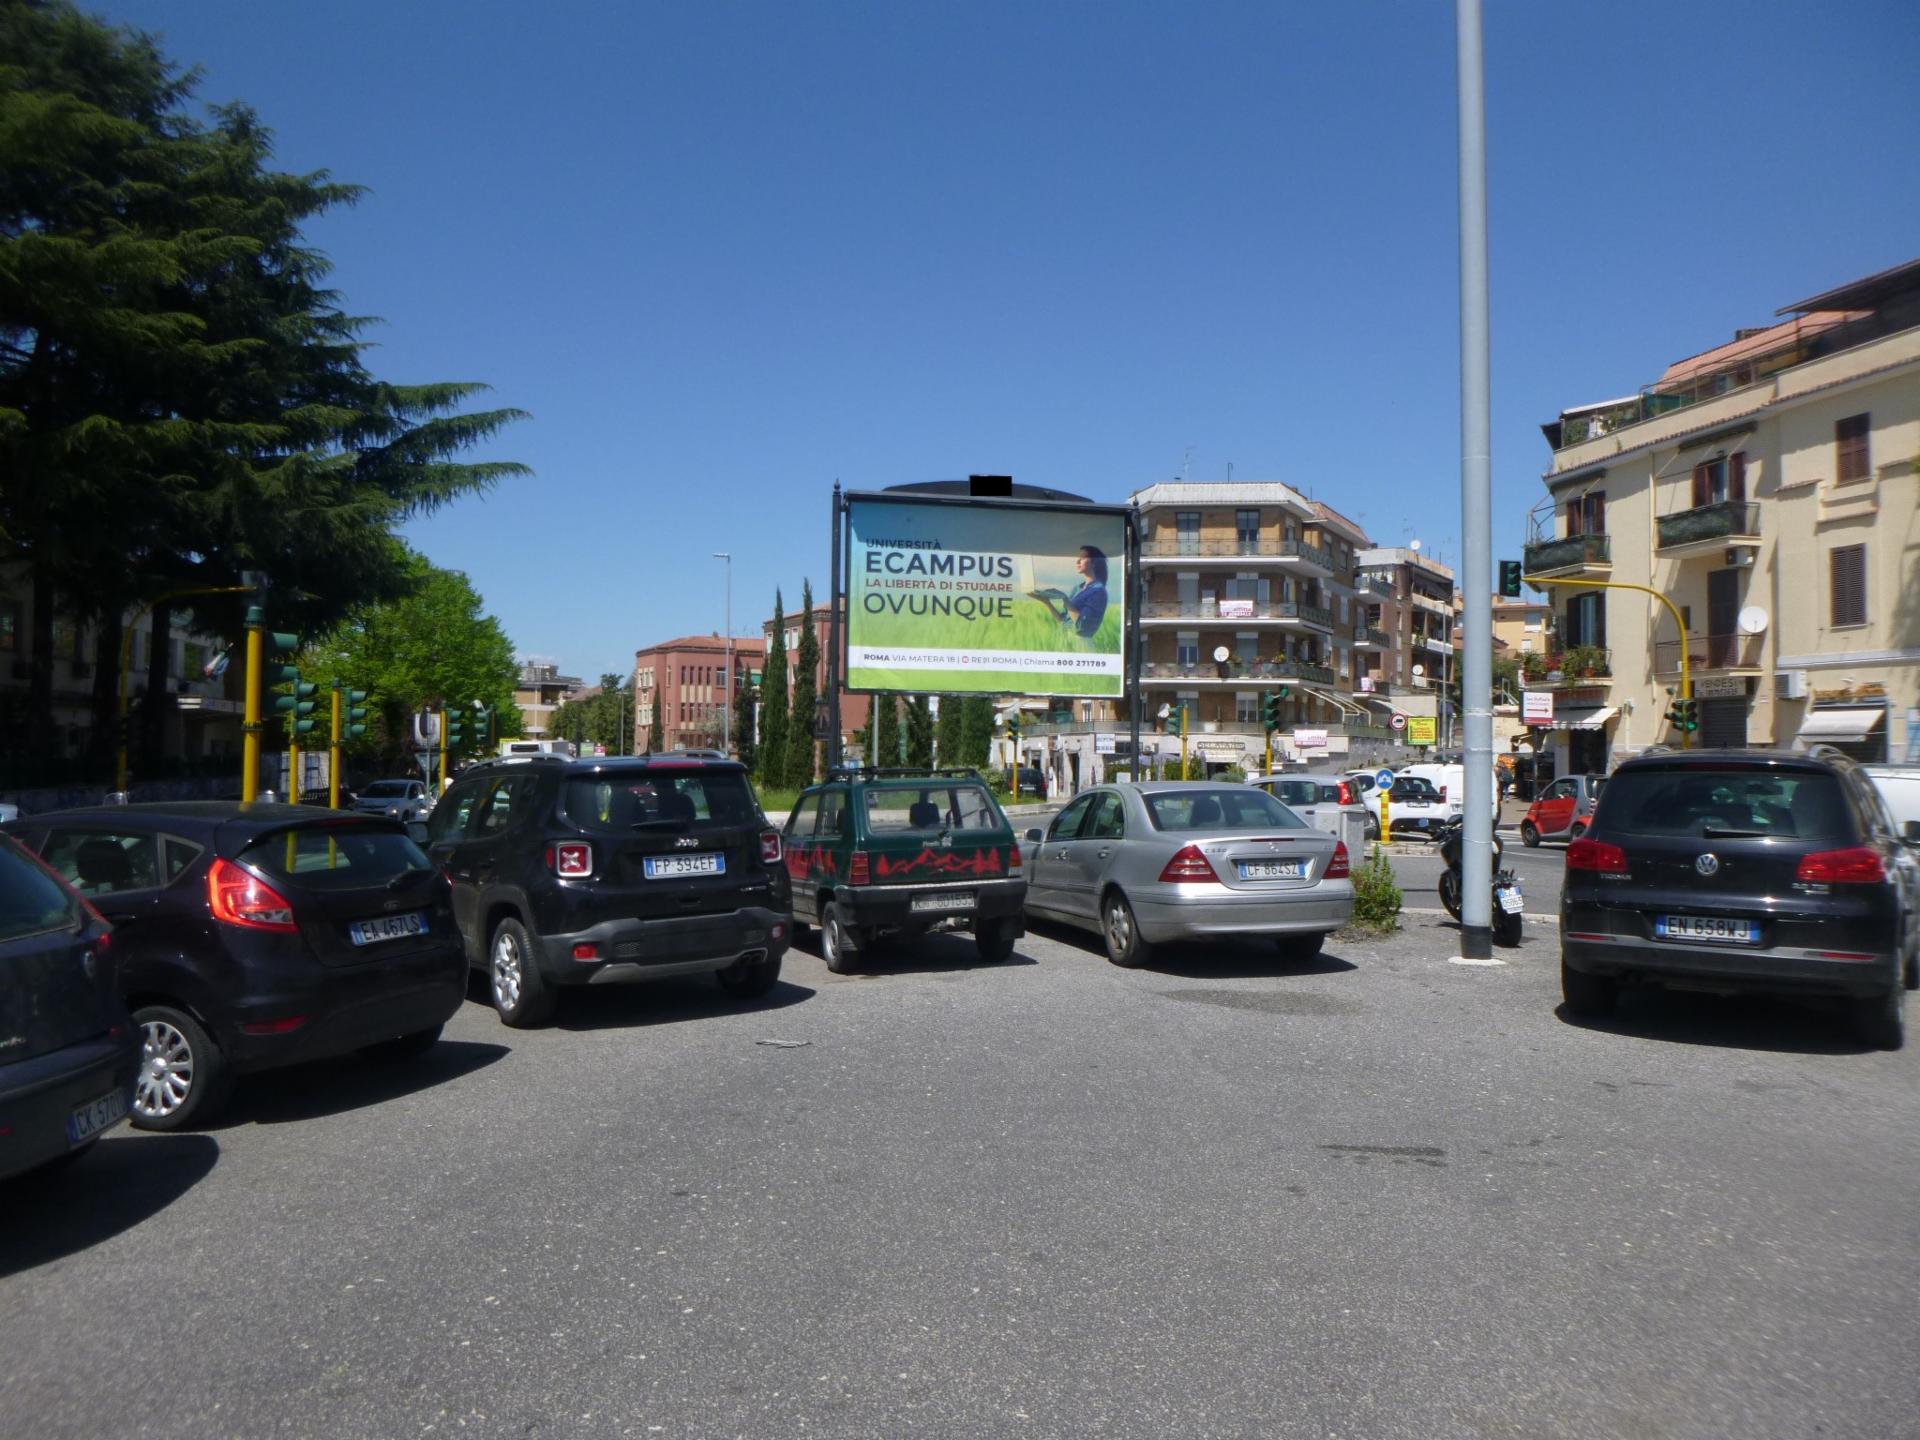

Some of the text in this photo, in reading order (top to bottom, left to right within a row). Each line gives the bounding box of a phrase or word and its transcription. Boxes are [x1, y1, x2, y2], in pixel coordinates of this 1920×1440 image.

[866, 538, 942, 550] UNIVERSITÀ
[866, 551, 1013, 578] ECAMPUS
[865, 578, 1013, 592] LA LIBERTÀ DI STUDIARE
[864, 593, 1014, 621] OVUNQUE
[864, 654, 890, 662] ROMA
[909, 655, 945, 663] MATERA
[1024, 658, 1055, 666] Chiama
[655, 857, 671, 873] FP
[1247, 862, 1297, 876] CF 864SZ
[360, 921, 381, 941] EA
[1668, 917, 1749, 938] EN 658WJ
